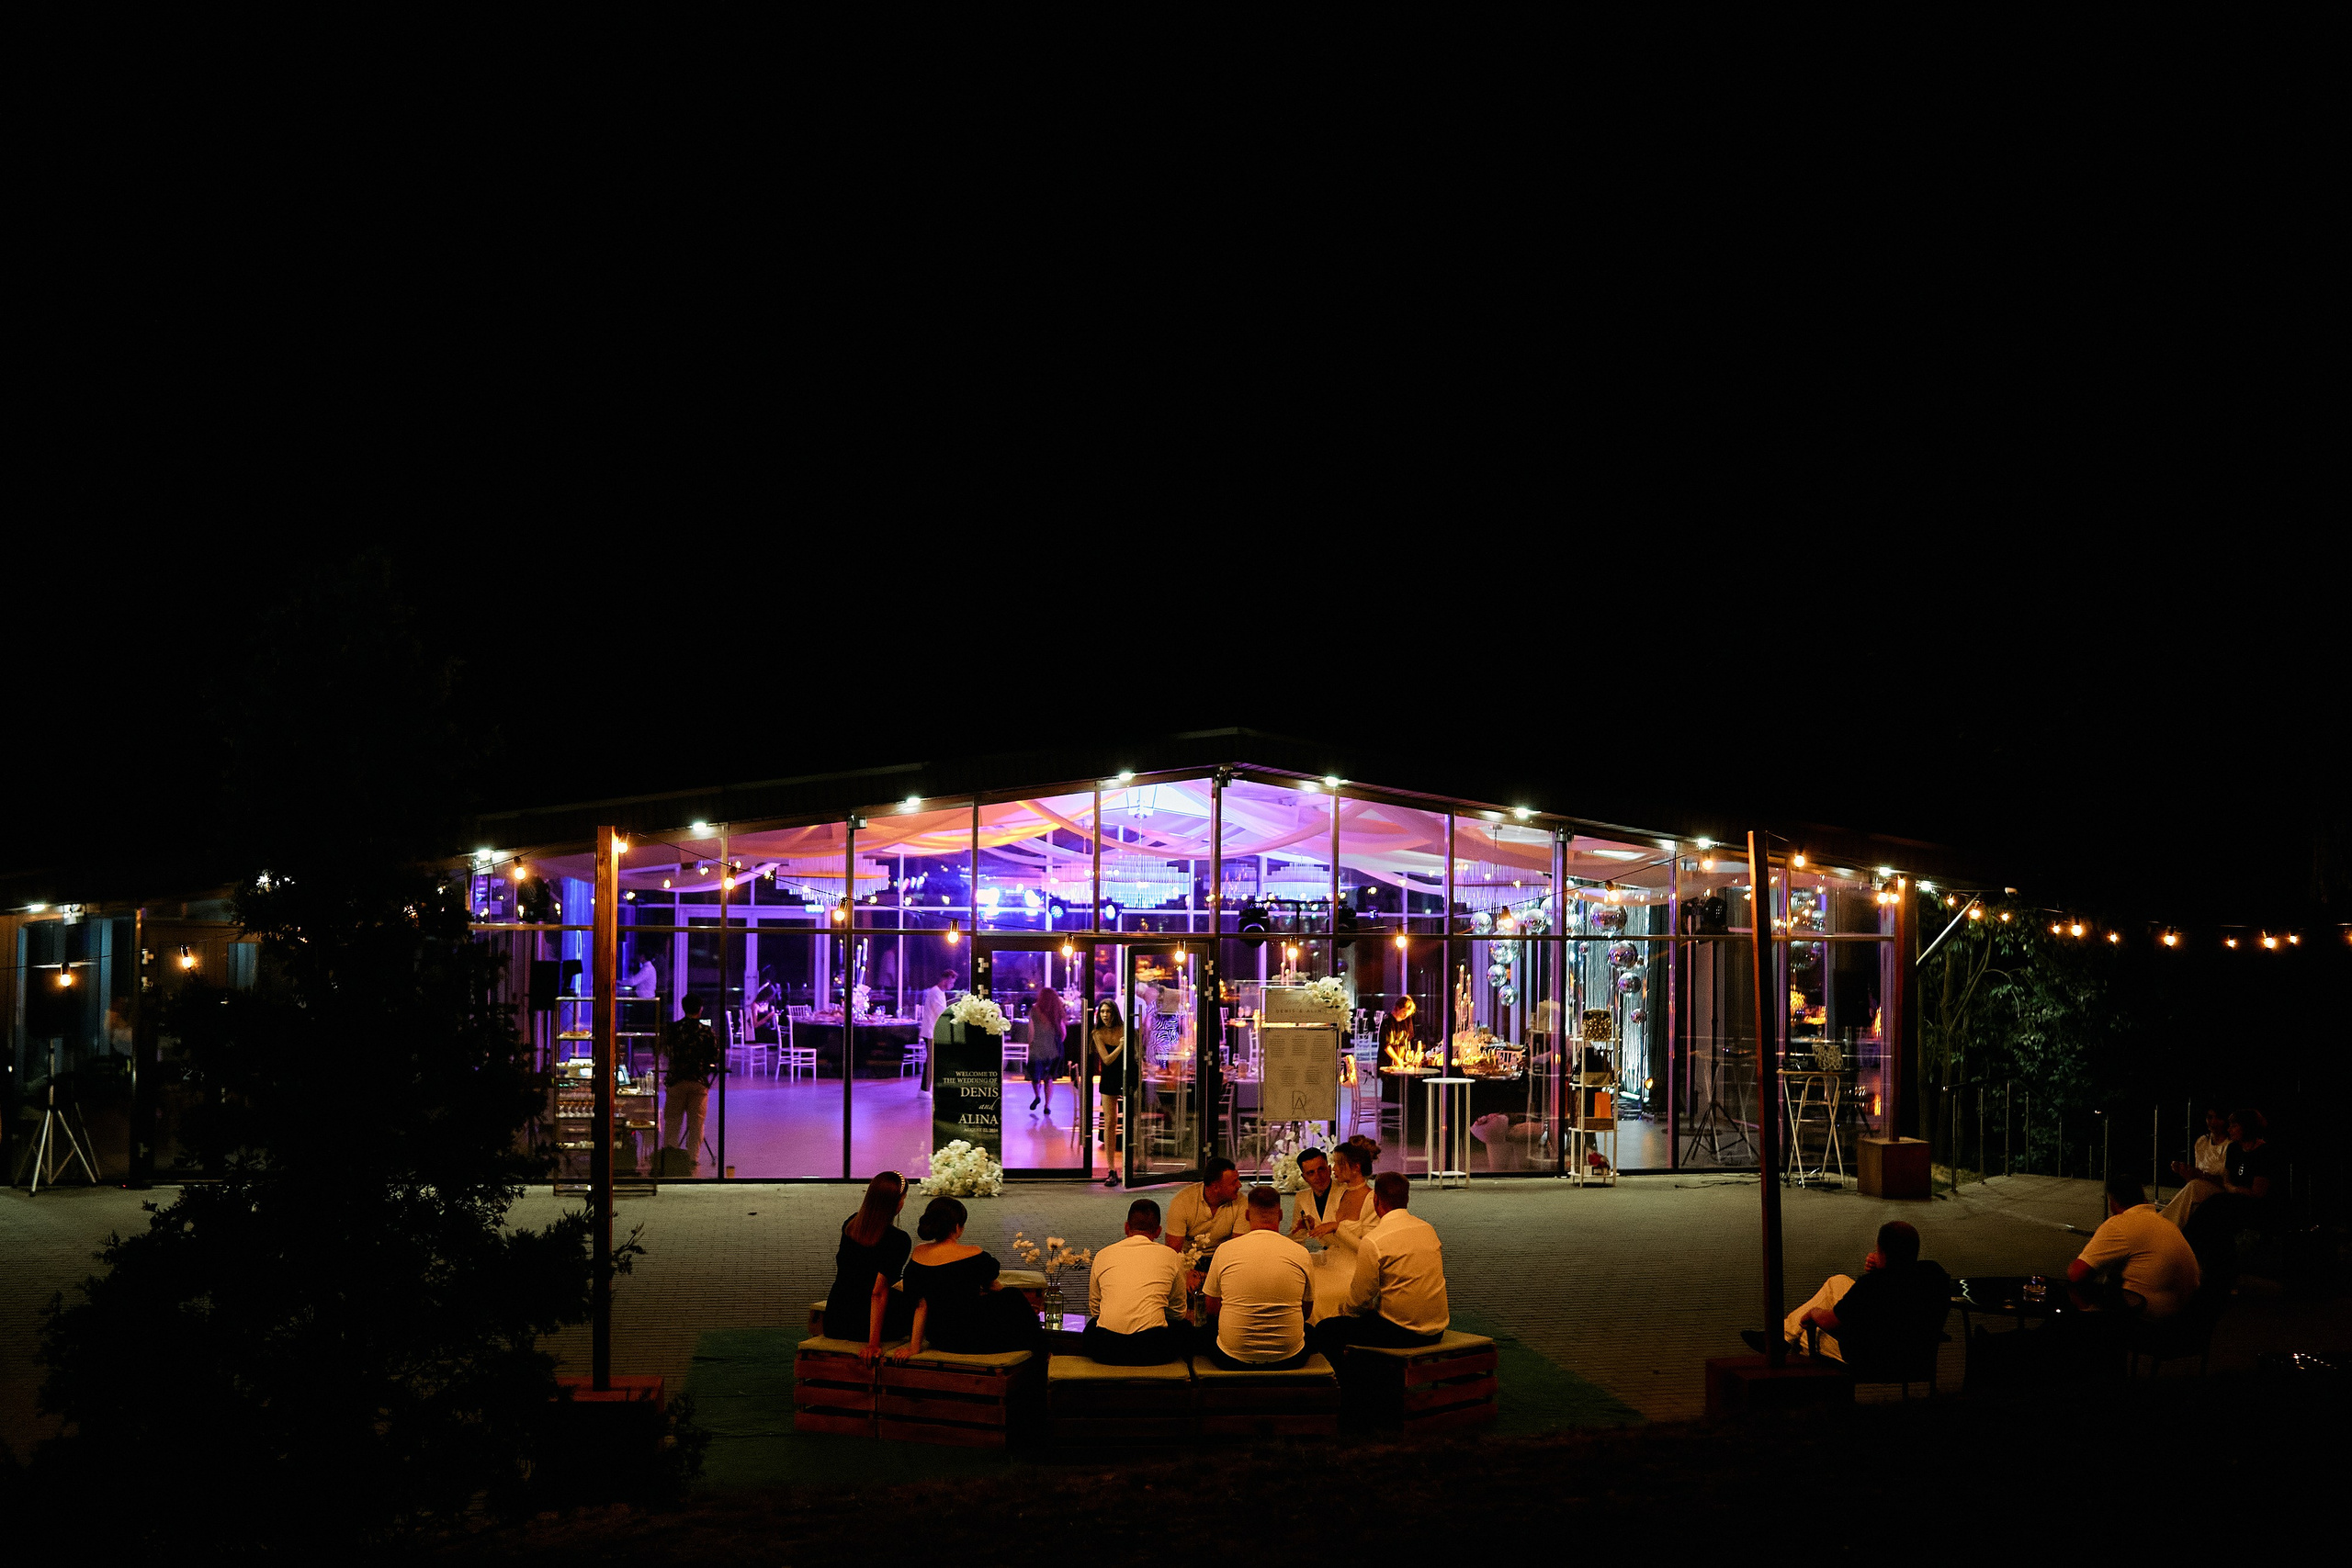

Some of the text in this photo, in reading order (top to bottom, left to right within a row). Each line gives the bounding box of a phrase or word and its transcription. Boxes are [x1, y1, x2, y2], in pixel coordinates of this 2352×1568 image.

[960, 1087, 999, 1098] DENIS
[978, 1097, 1001, 1111] and
[958, 1114, 999, 1124] ALINA
